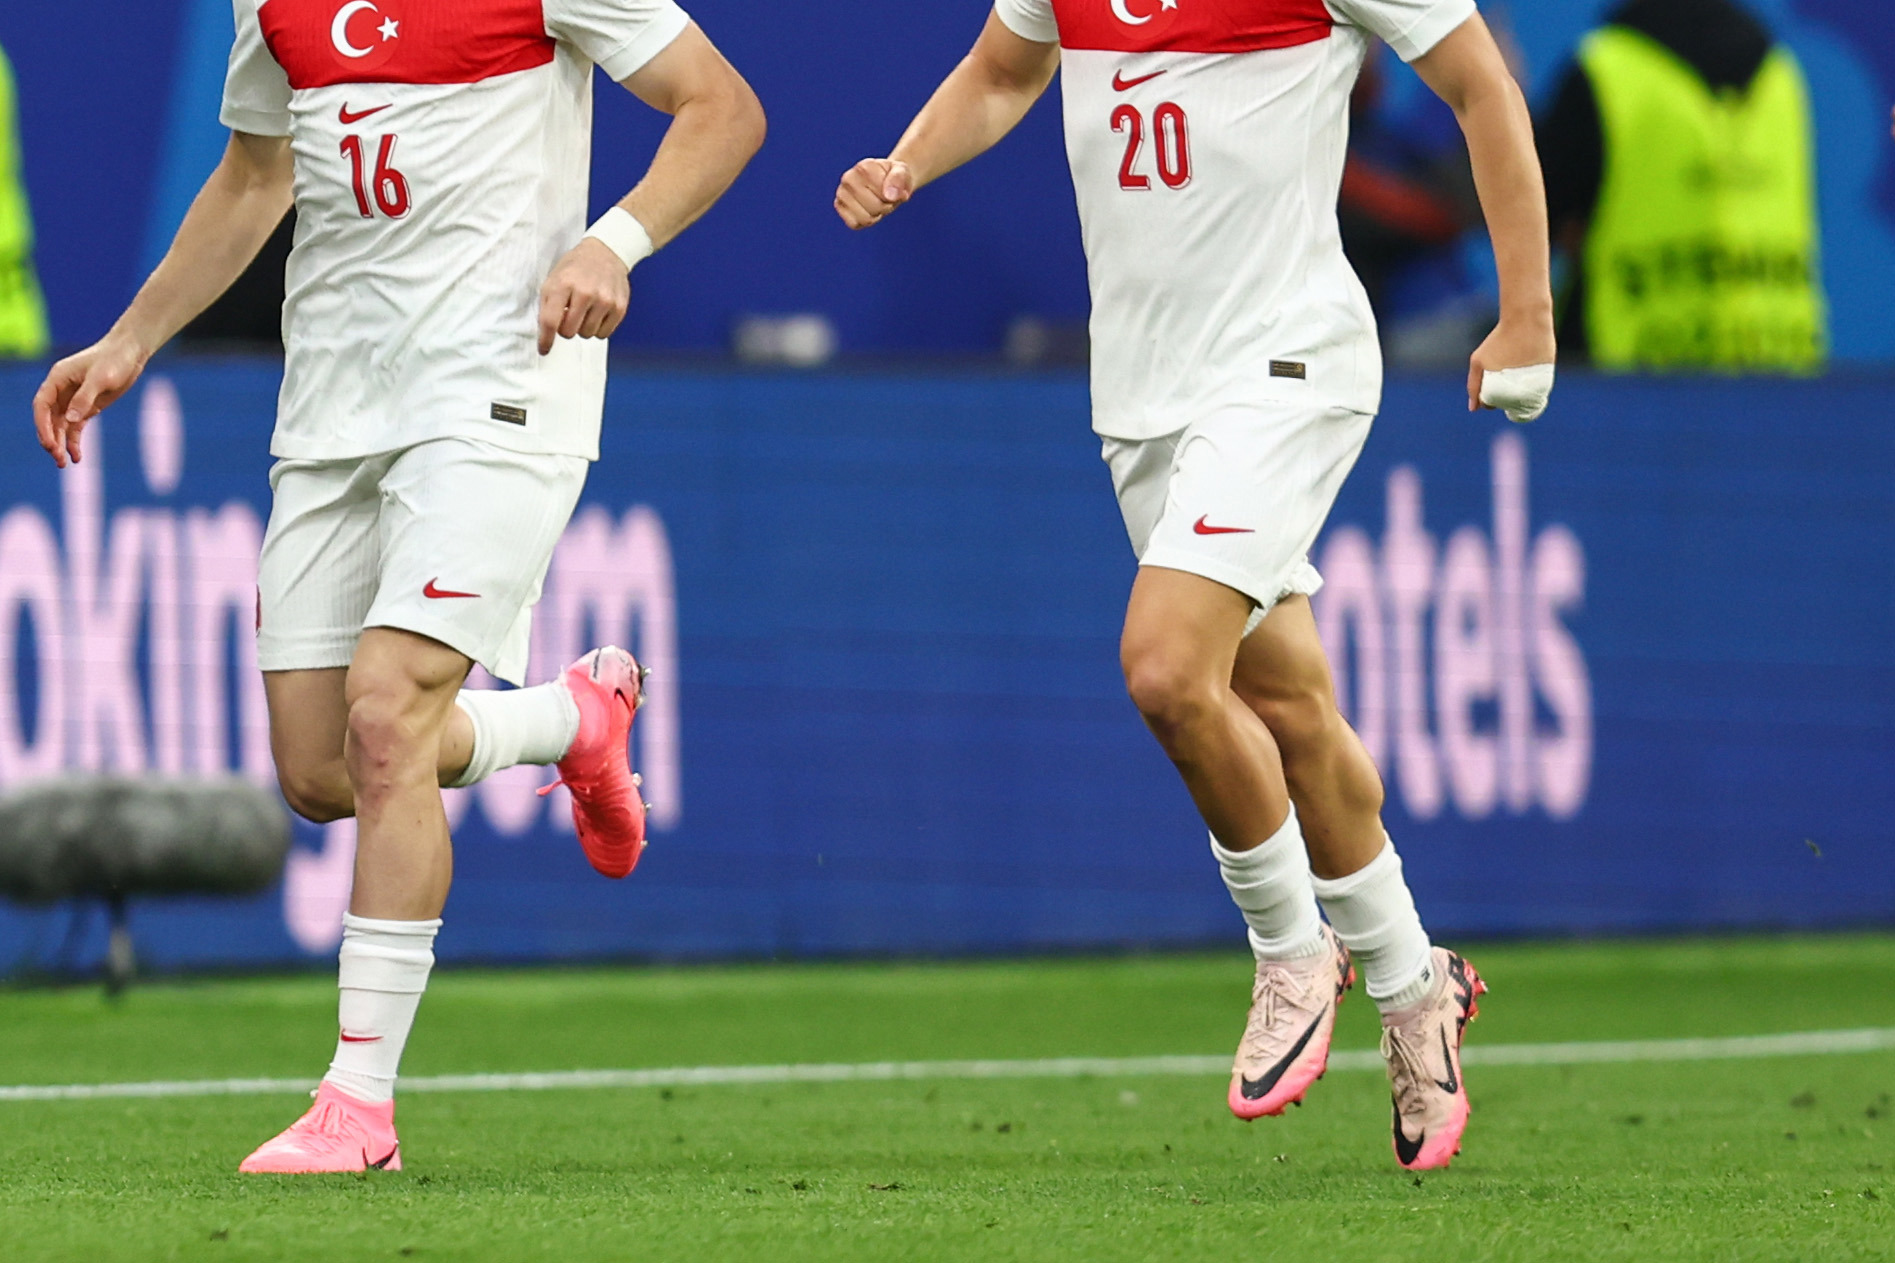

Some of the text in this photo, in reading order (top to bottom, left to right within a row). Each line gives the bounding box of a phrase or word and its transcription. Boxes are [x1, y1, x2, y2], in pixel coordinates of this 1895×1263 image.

[338, 132, 413, 220] 16
[1110, 101, 1193, 191] 20
[1310, 429, 1594, 820] otels
